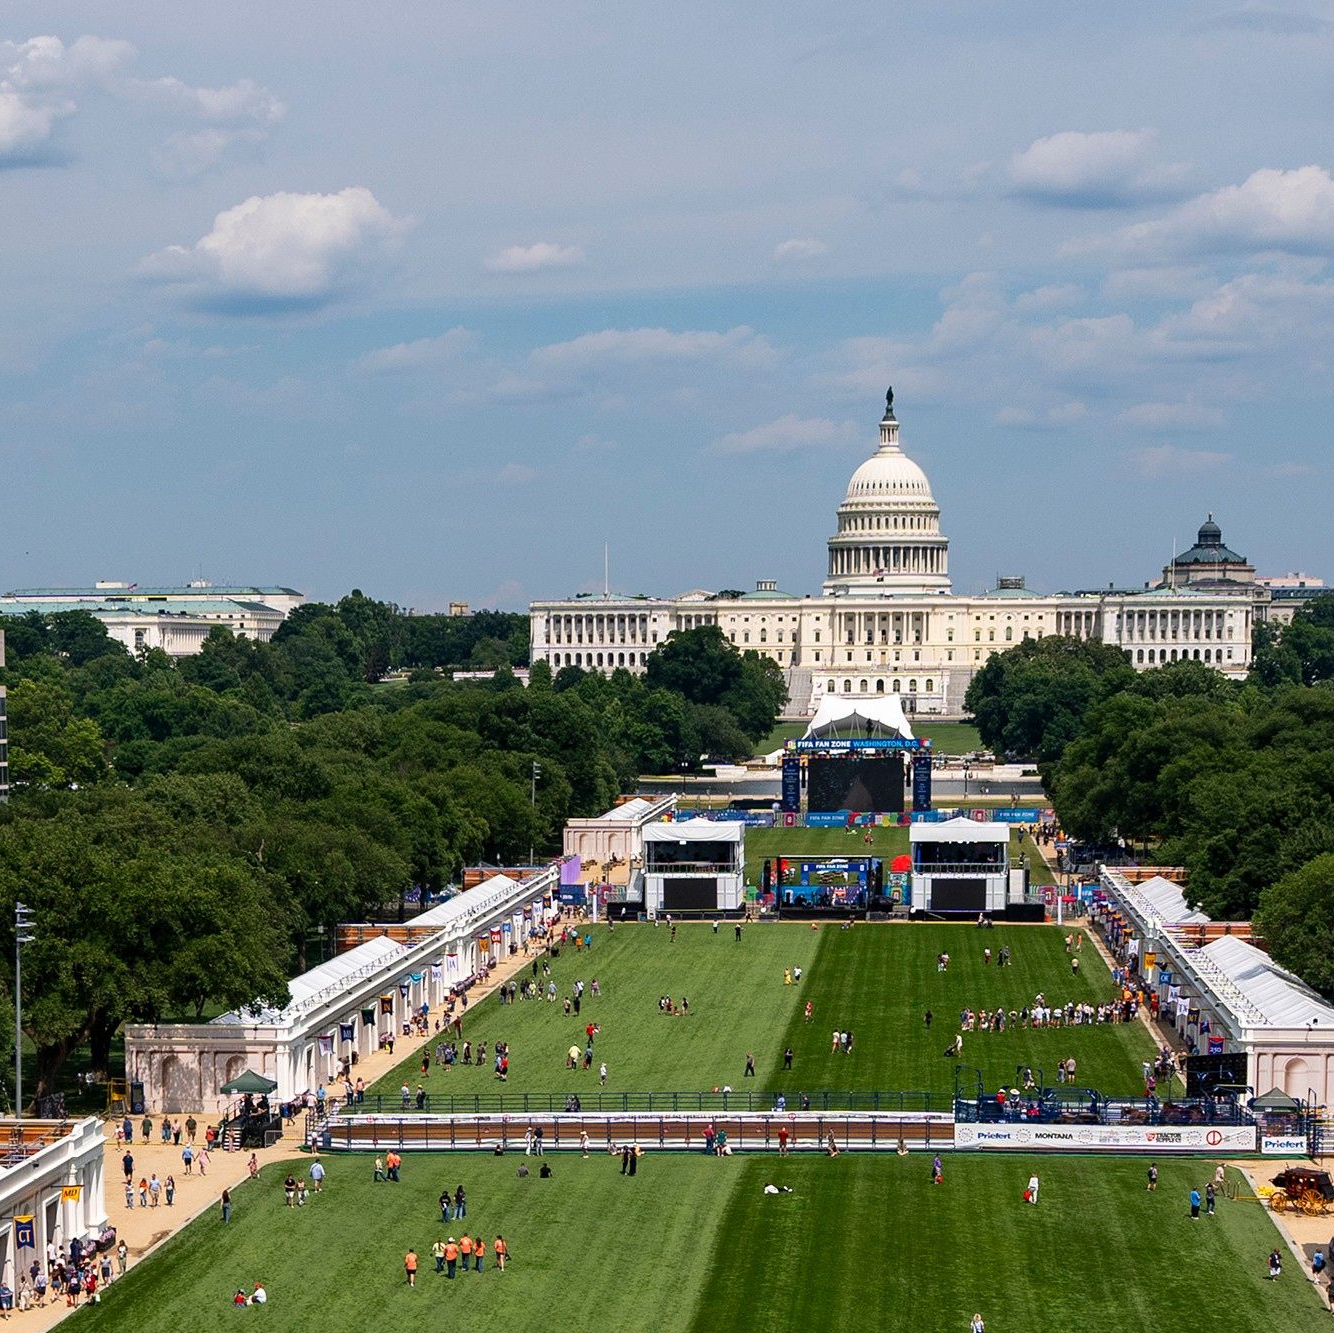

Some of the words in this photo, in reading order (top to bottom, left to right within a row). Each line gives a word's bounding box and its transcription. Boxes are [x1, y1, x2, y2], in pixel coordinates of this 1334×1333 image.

[853, 741, 903, 749] WASHINGTON,
[977, 1132, 1011, 1140] Priefert
[1264, 1140, 1304, 1148] Priefert
[19, 1230, 31, 1242] CT
